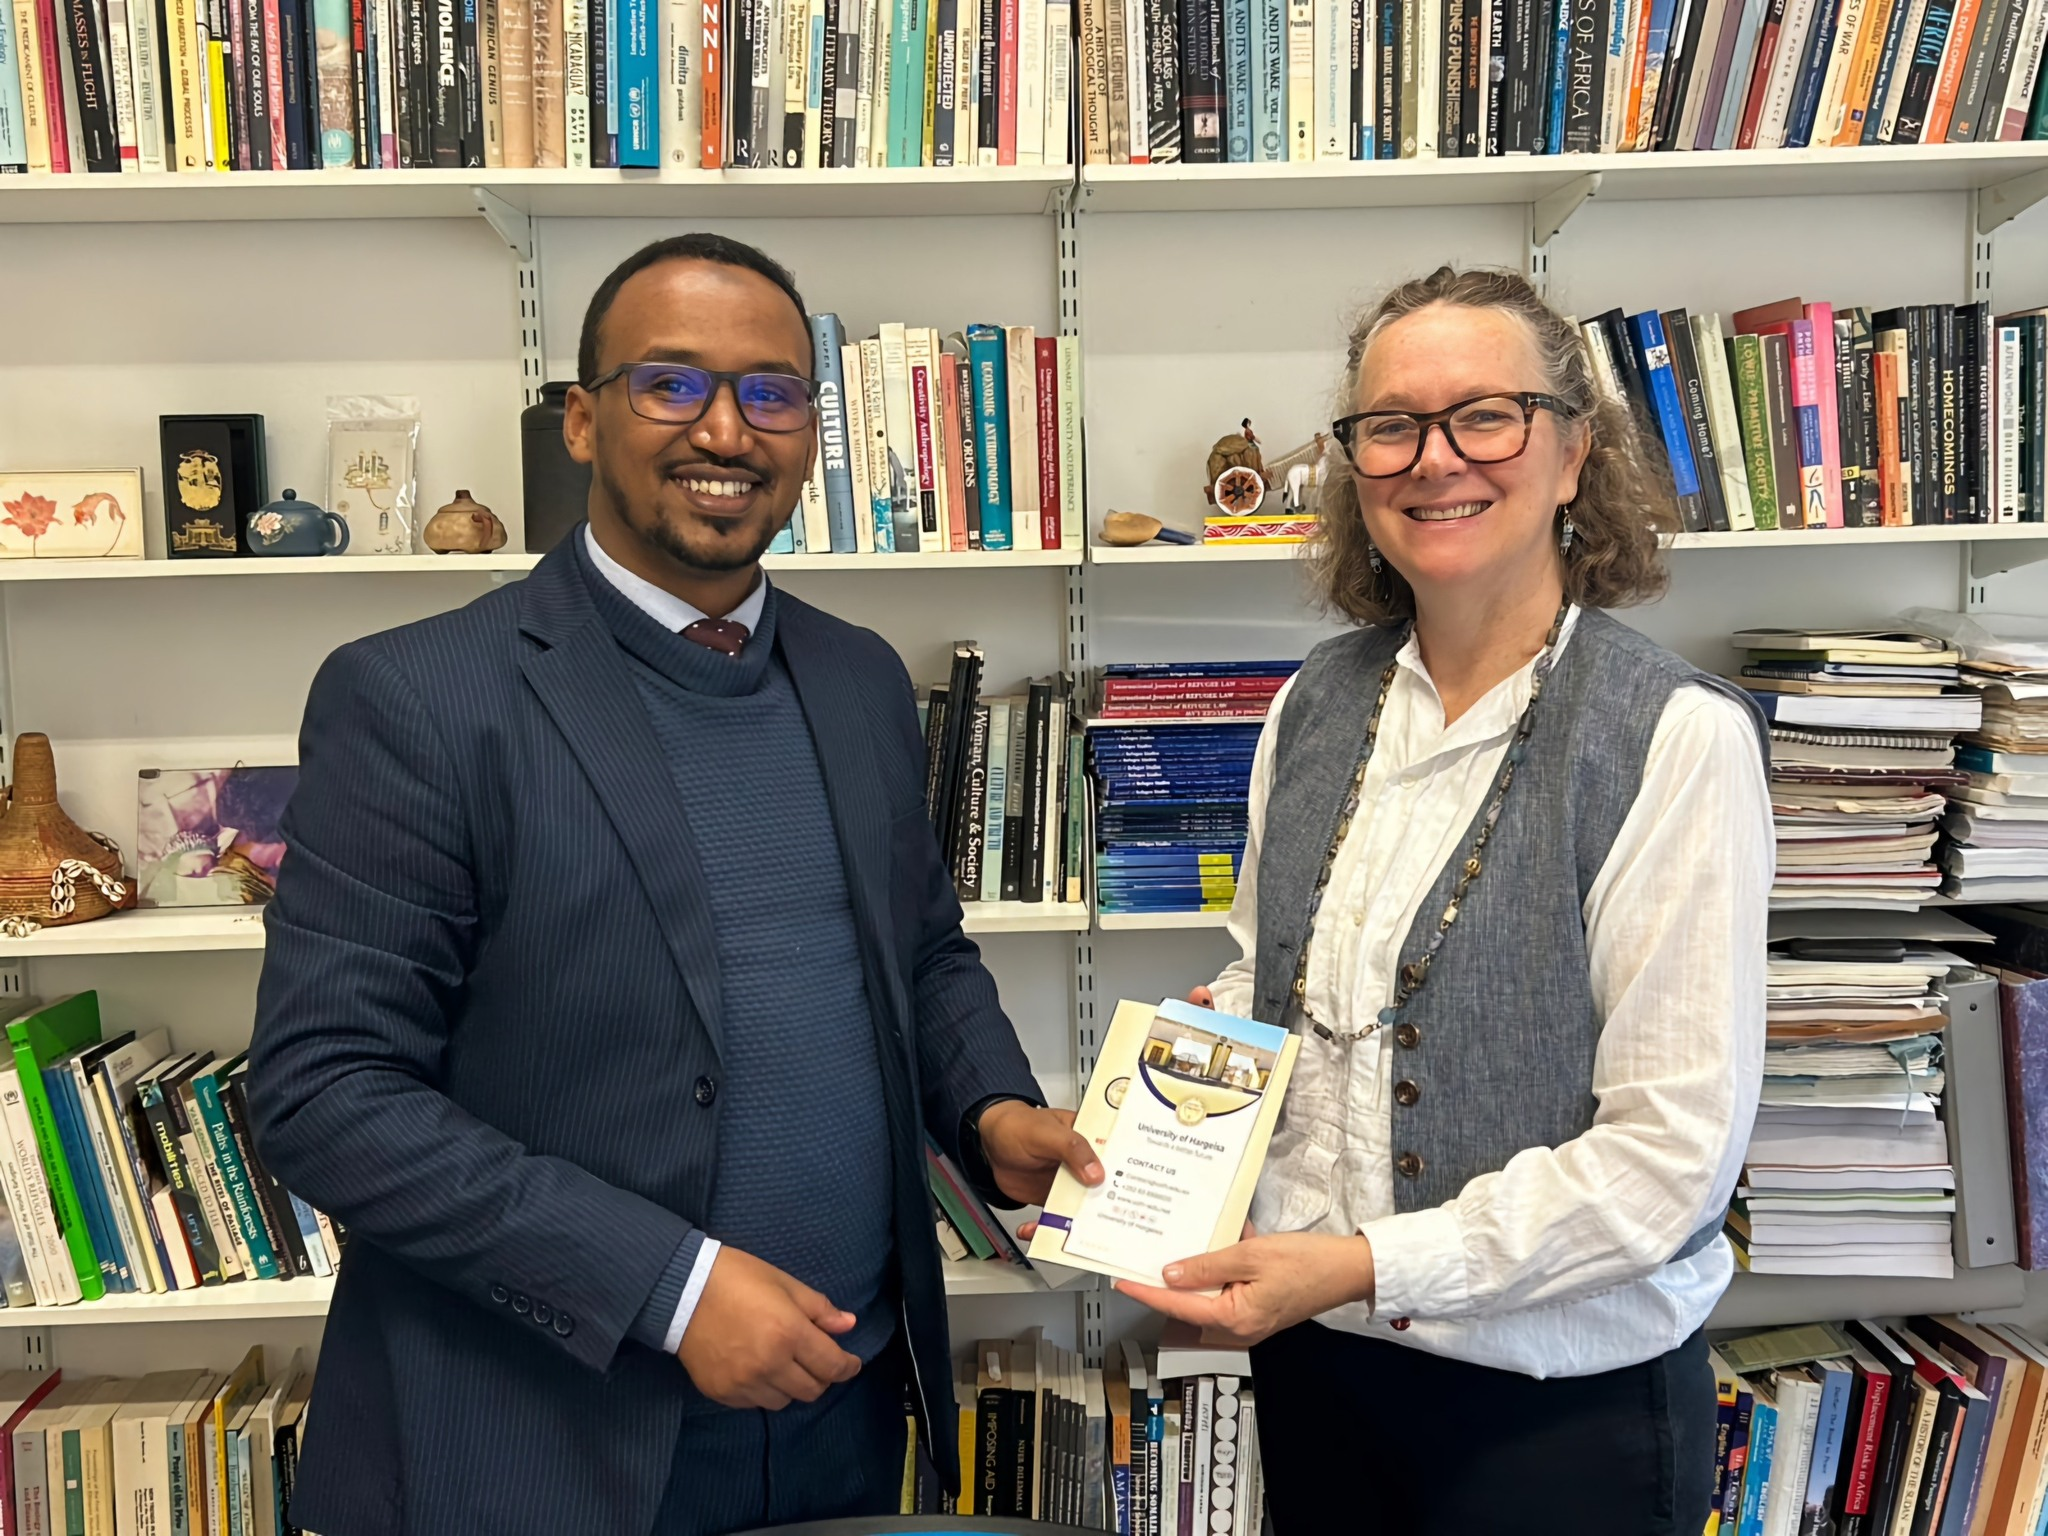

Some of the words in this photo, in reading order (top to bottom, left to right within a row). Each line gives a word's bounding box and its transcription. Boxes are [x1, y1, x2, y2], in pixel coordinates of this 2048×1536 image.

[71, 0, 88, 48] MASSES
[790, 4, 796, 12] of
[1198, 9, 1208, 33] AND
[1846, 14, 1857, 28] OF
[177, 18, 186, 57] MIGRATION
[250, 39, 259, 53] FAT
[413, 20, 422, 65] refugees
[487, 13, 496, 60] AFRICAN
[788, 29, 796, 63] Religious
[796, 21, 804, 63] Elementary
[1210, 14, 1220, 65] Handbook
[1449, 33, 1462, 44] &
[1492, 10, 1502, 48] EARTH
[1576, 16, 1595, 44] OF
[1838, 31, 1851, 54] WAR
[1916, 5, 1951, 66] AFRICA
[1998, 12, 2020, 74] Indifference
[80, 51, 88, 60] IN
[251, 55, 259, 68] OF
[568, 32, 584, 96] NICARAGUA?
[678, 45, 690, 85] dimitra
[824, 25, 837, 88] LITERARY
[942, 30, 954, 110] UNPROTECTED
[981, 42, 996, 96] Development
[1096, 37, 1105, 80] HISTORY
[1110, 20, 1124, 102] INTELLECTUALS
[1188, 26, 1198, 76] STUDIES
[1200, 36, 1210, 80] FORCED
[1404, 44, 1412, 82] SYSTEMS
[1784, 38, 1798, 78] POWER
[1942, 16, 1968, 95] DEVELOPMENT
[81, 63, 98, 110] FLIGHT
[180, 69, 189, 95] GLOBAL
[252, 70, 261, 88] OUR
[488, 65, 497, 105] GENIUS
[595, 64, 605, 105] BLUES
[1098, 83, 1106, 96] OF
[1210, 67, 1222, 80] of
[1446, 46, 1462, 97] PUNISH
[1572, 47, 1594, 120] AFRICA
[2020, 45, 2039, 99] DIFFERENCE
[253, 90, 262, 117] SOULS
[1490, 87, 1498, 108] Mark
[1773, 86, 1786, 122] PLACE
[182, 97, 193, 139] PROCESSES
[822, 95, 834, 148] THEORY
[1088, 91, 1098, 143] THOUGHT
[822, 332, 830, 368] KUPER
[1743, 342, 1756, 380] LOWIE
[917, 370, 928, 419] Creativity
[982, 361, 995, 416] ECONOMIC
[1045, 368, 1053, 392] Chinese
[1910, 358, 1919, 411] Anthropology
[1928, 356, 1937, 409] Anthropology
[820, 380, 845, 470] CULTURE
[1044, 393, 1054, 428] Agricultural
[1064, 402, 1073, 440] DIVINITY
[1687, 379, 1704, 420] Coming
[1696, 424, 1712, 458] Home?
[1748, 390, 1764, 448] PRIMITIVE
[1045, 429, 1054, 462] Technology
[1912, 422, 1921, 452] Cultural
[1930, 420, 1939, 450] Cultural
[1943, 370, 1955, 494] HOMECOMINGS
[919, 420, 932, 486] Anthropology
[984, 422, 1000, 506] ANTHROPOLOGY
[1066, 442, 1074, 462] AND
[1913, 452, 1922, 483] Critique
[1930, 450, 1939, 482] Critique
[1066, 464, 1074, 512] EXPERIENCE
[1755, 453, 1770, 500] SOCIETY
[970, 710, 988, 766] Woman,
[970, 768, 985, 820] Culture
[970, 822, 981, 834] &
[964, 837, 980, 888] Society
[188, 1106, 200, 1126] VAN
[211, 1122, 228, 1151] Paths
[1138, 1122, 1178, 1142] University
[1179, 1134, 1188, 1144] of
[1188, 1134, 1225, 1153] Hargeisa
[190, 1157, 209, 1194] FORCED
[207, 1162, 218, 1178] THE
[222, 1153, 233, 1165] in
[225, 1166, 238, 1181] the
[1127, 1157, 1163, 1173] CONTACT
[1166, 1168, 1176, 1176] US
[16, 1140, 32, 1182] WORLD'S
[28, 1184, 46, 1226] REFUGEES
[46, 1234, 57, 1256] 2000
[154, 1122, 186, 1189] mobilities
[186, 1213, 203, 1246] urry
[202, 1194, 212, 1206] TO
[212, 1178, 224, 1200] RITES
[206, 1208, 220, 1229] FLEE
[220, 1202, 230, 1212] OF
[232, 1182, 258, 1240] Rainforests
[1097, 1212, 1127, 1224] University
[224, 1214, 242, 1246] PASSAGE
[1865, 1380, 1884, 1442] Displacement
[1923, 1410, 1930, 1418] A
[986, 1412, 998, 1466] IMPOSING
[1717, 1423, 1730, 1457] English
[1914, 1418, 1930, 1454] HISTORY
[171, 1456, 181, 1484] People
[1149, 1442, 1158, 1492] BECOMING
[1182, 1435, 1192, 1480] Tomorrow
[1858, 1470, 1868, 1480] in
[1860, 1444, 1873, 1469] Risks
[1911, 1456, 1922, 1468] OF
[174, 1484, 183, 1494] of
[985, 1470, 996, 1490] AID
[1016, 1466, 1024, 1511] DILEMMAS
[1116, 1470, 1125, 1512] AMAN
[1853, 1480, 1866, 1510] Africa
[1907, 1470, 1919, 1488] THE
[174, 1495, 183, 1507] the
[174, 1509, 184, 1528] Plow
[1756, 1482, 1768, 1520] ENGLISH
[1900, 1490, 1914, 1520] SUDAN
